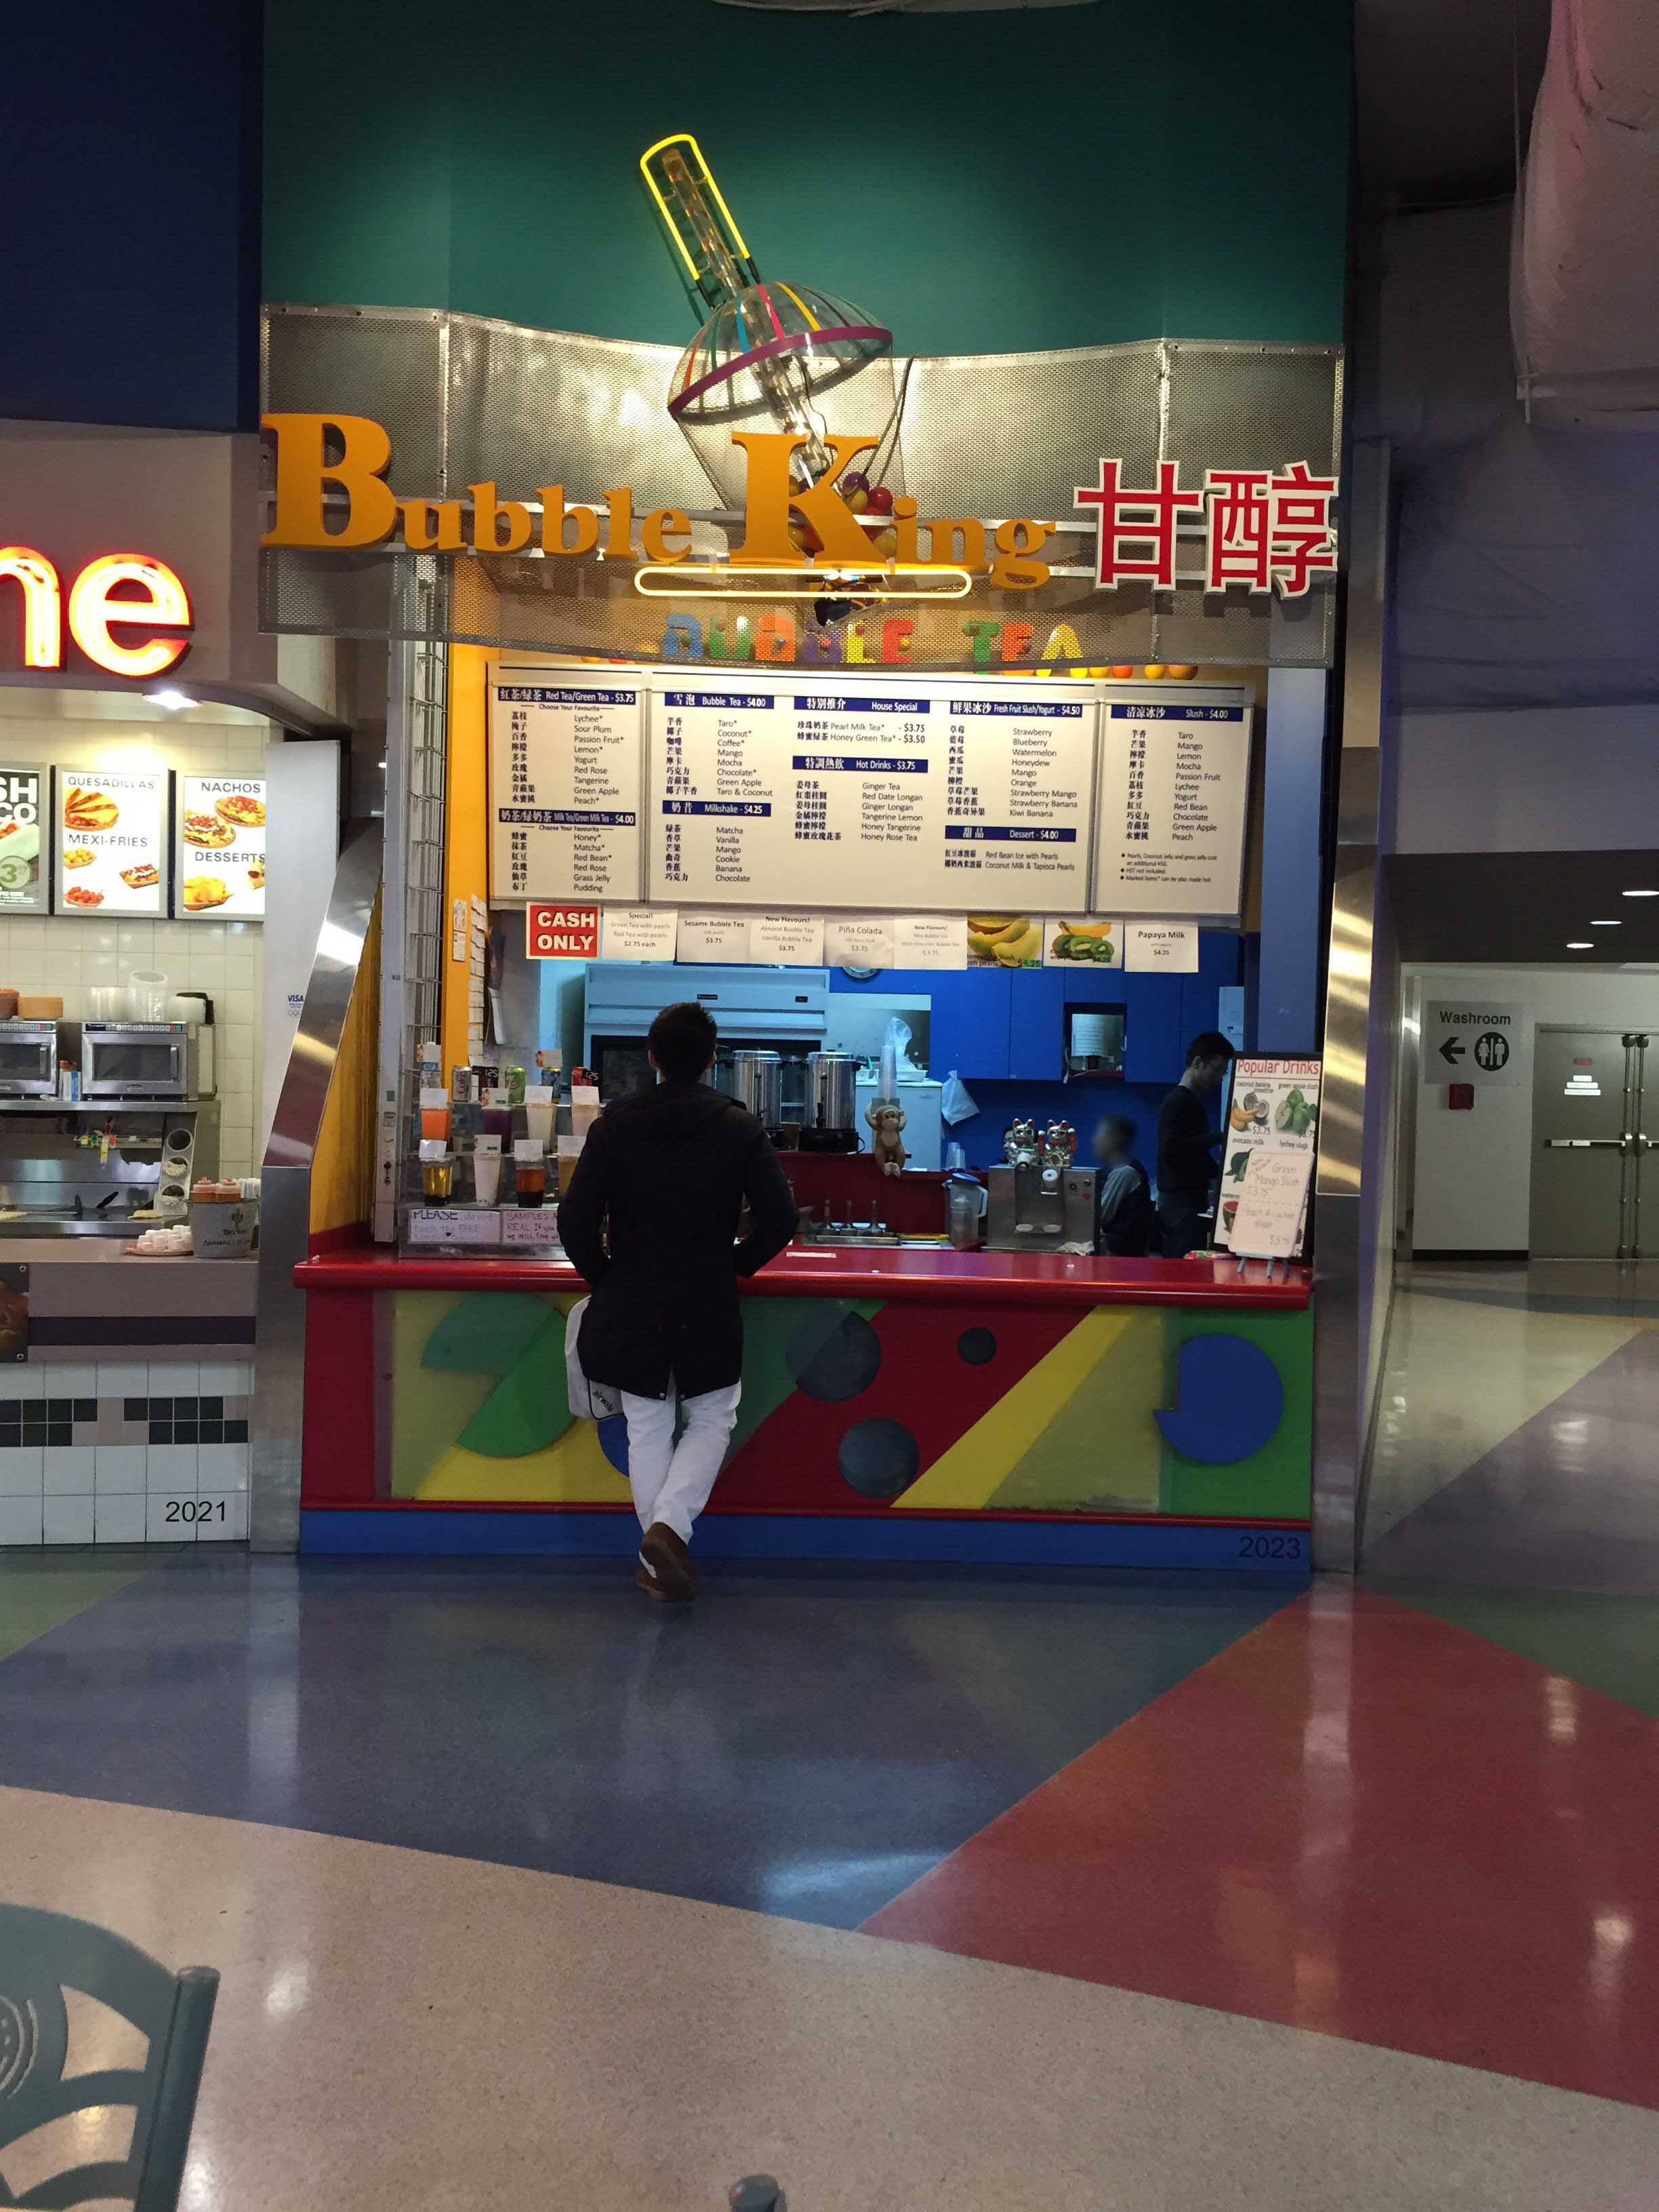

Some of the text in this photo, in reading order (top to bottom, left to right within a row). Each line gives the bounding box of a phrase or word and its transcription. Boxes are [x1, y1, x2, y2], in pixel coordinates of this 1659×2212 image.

[260, 413, 1056, 590] Bubble King
[1073, 457, 1339, 600] 甘醇
[546, 691, 559, 700] Red
[561, 692, 596, 701] Tea/Green
[615, 693, 634, 702] $3.75
[703, 697, 766, 707] Bubble Tea $4.00
[895, 703, 918, 712] Special
[994, 705, 1007, 713] Fresh
[1010, 705, 1021, 713] Fruit
[1062, 706, 1080, 715] $4.50
[1210, 710, 1228, 718] $4.00
[1013, 729, 1052, 737] Strawberry
[1012, 738, 1047, 747] Blueberry
[857, 760, 915, 770] Hot Drinks $3.75
[1012, 759, 1050, 767] Honeydew
[68, 776, 155, 790] QUESADILLAS
[201, 782, 261, 794] NACHOS
[1011, 779, 1036, 787] Orange
[897, 794, 922, 802] Longan
[1010, 790, 1077, 798] Strawberry Mango
[705, 804, 762, 814] Milkshake $4.25
[615, 815, 634, 823] $4.00
[1010, 830, 1059, 839] Dessert $4.00
[68, 834, 148, 848] MEXI-FRIES
[574, 884, 602, 893] Pudding
[537, 912, 595, 928] CASH
[1138, 931, 1166, 939] Papaya
[537, 935, 594, 951] ONLY
[1439, 1010, 1511, 1025] Washroom
[1237, 1060, 1319, 1076] Popular Drinks
[413, 1210, 459, 1220] PLEASE
[165, 1500, 226, 1522] 2021
[1240, 1536, 1300, 1559] 2023
